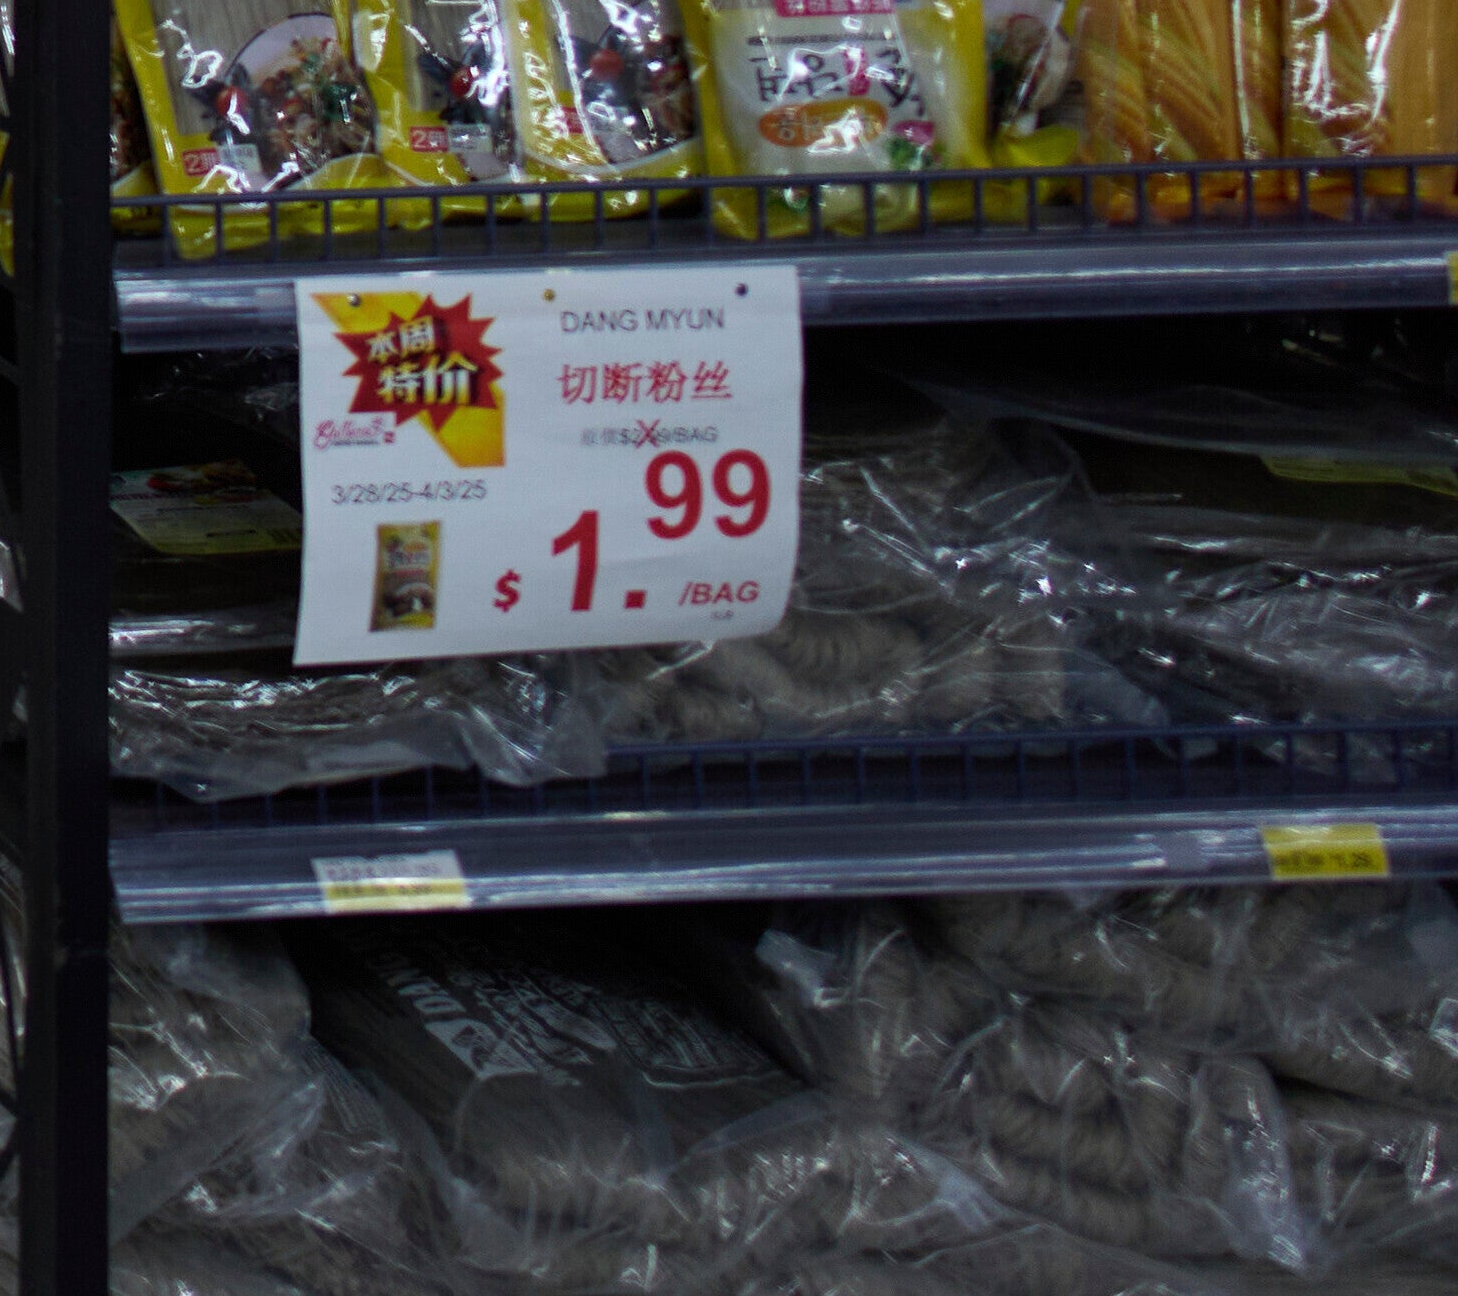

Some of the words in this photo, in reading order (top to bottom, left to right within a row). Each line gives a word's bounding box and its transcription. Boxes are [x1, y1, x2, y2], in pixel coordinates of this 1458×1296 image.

[364, 317, 435, 367] 本周
[560, 308, 638, 334] DANG
[645, 307, 725, 332] MYUN
[376, 351, 479, 406] 特价
[556, 361, 734, 406] 切断粉丝
[331, 478, 488, 505] 3/28/25-4/3/25
[645, 449, 771, 540] 99
[493, 568, 521, 613] $
[678, 581, 761, 606] /BAG
